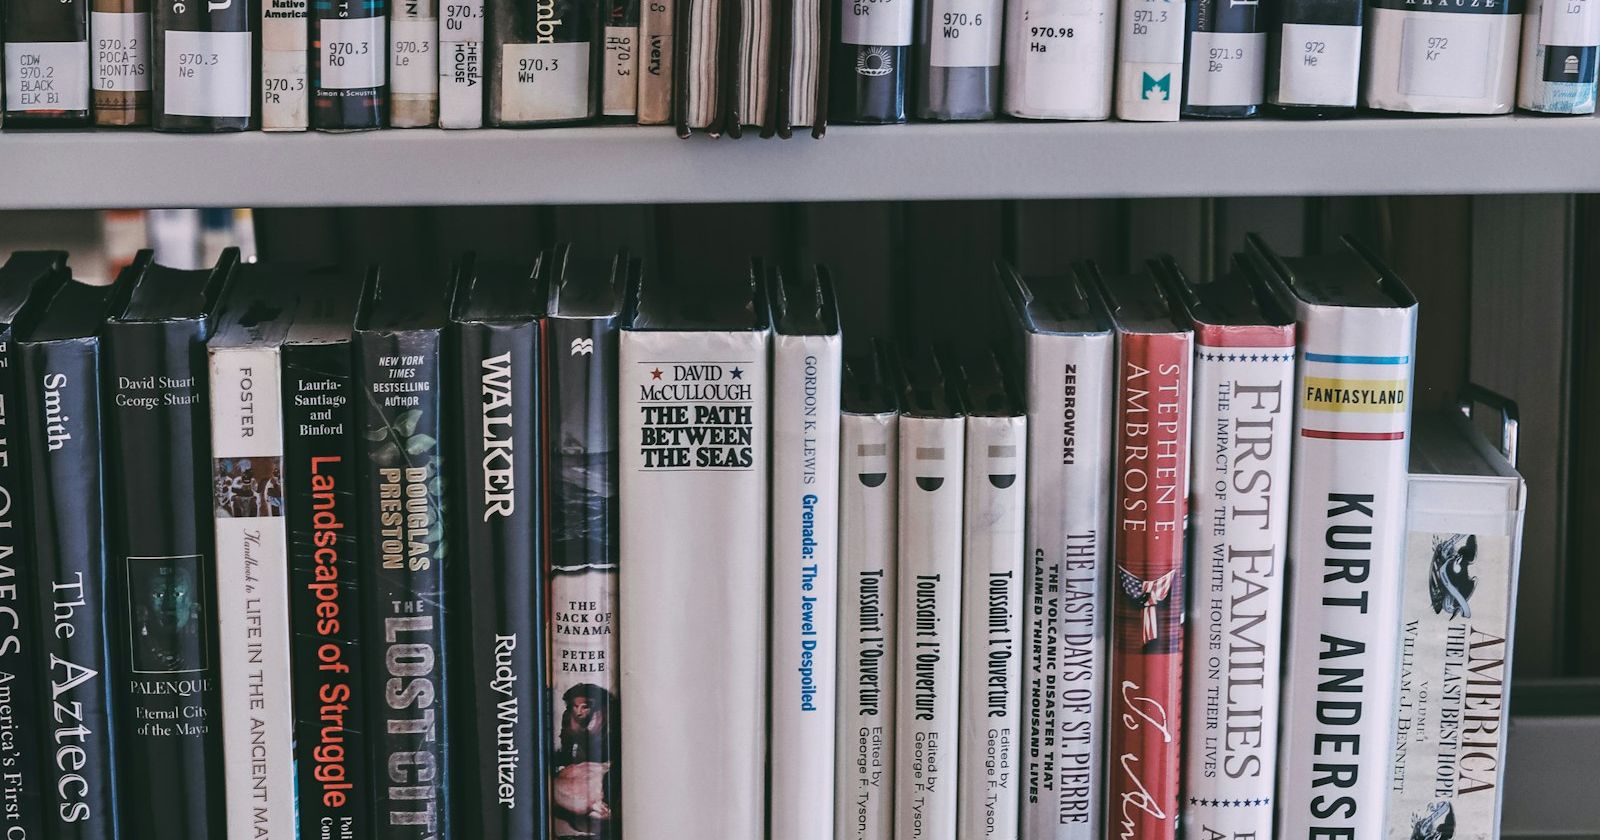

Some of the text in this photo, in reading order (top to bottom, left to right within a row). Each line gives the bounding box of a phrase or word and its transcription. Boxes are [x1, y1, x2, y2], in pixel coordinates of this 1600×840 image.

[272, 0, 305, 8] Native
[446, 5, 484, 18] 970.3
[944, 13, 982, 26] 970.6
[1133, 10, 1168, 22] 971.3
[1031, 26, 1074, 38] 970.98
[99, 38, 137, 50] 970.2
[329, 42, 368, 55] 970.3
[396, 42, 429, 53] 970.3
[1030, 42, 1046, 52] Ha
[1304, 42, 1325, 54] 972
[1428, 37, 1448, 50] 972
[20, 55, 41, 66] CDW
[179, 54, 219, 66] 970.3
[396, 54, 409, 66] Le
[618, 37, 630, 76] 970.3
[1209, 48, 1243, 60] 971.9
[1304, 55, 1317, 66] He
[1426, 50, 1440, 61] Kr
[99, 64, 145, 76] HONTAS
[179, 66, 194, 78] Ne
[455, 44, 465, 83] HOUSE
[518, 58, 558, 71] 970.3
[1208, 60, 1222, 72] Be
[20, 67, 54, 78] 970.2
[20, 80, 54, 92] BLACK
[264, 78, 304, 91] 970.3
[20, 92, 42, 104] ELK
[379, 356, 425, 366] NEW YORK
[388, 368, 415, 378] TIMES
[673, 366, 722, 381] DAVID
[118, 376, 195, 390] David Stuart
[298, 379, 342, 391] Lauria-
[373, 382, 430, 392] BESTSELLING
[294, 394, 347, 406] Santiago
[640, 384, 752, 400] McCULLOUGH
[1307, 386, 1404, 404] FANTASYLAND
[115, 392, 200, 410] George Stuart
[239, 366, 254, 438] FOSTER
[384, 396, 420, 406] AUTHOR
[44, 373, 72, 452] Smith
[310, 410, 332, 420] and
[640, 406, 752, 424] THE PATH
[1063, 364, 1076, 464] ZEBROWSKI
[300, 424, 343, 436] Binford
[482, 351, 514, 522] WALKER
[640, 426, 752, 446] BETWEEN
[1122, 362, 1150, 532] AMBROSE
[1154, 363, 1180, 540] STEPHEN E.
[1232, 380, 1282, 530] FIRST
[640, 448, 753, 468] THE SEAS
[380, 468, 404, 570] PRESTON
[406, 467, 430, 572] DOUGLAS
[798, 356, 818, 712] GORDON K. LEWIS Grenada: The Jewel Despoiled
[1322, 492, 1374, 614] KURT
[1204, 381, 1230, 778] THE IMPACT OF THE WHITE HOUSE ON THEIR LIVES
[391, 600, 424, 614] THE
[569, 602, 596, 610] THE
[556, 612, 612, 623] SACK OF
[308, 456, 353, 808] Landscapes of Struggle
[859, 569, 884, 716] Toussaint L'Ouverture
[915, 574, 940, 721] Toussaint L'Ouverture
[988, 570, 1012, 718] Toussaint L'Ouverture
[562, 650, 606, 660] PETER
[1224, 544, 1276, 778] FAMILIES
[244, 528, 268, 802] Handbook to LIFE IN THE ANCIENT
[562, 662, 606, 672] EARLE
[385, 616, 436, 742] LOST
[1029, 548, 1044, 804] CLAIMED THIRTY THOUSAND LIVES
[1043, 564, 1058, 791] THE VOLCANIC DISASTER THAT
[1060, 530, 1096, 824] THE LAST DAYS OF ST. PIERRE
[130, 678, 212, 696] PALENQUE
[50, 571, 98, 822] The Aztecs
[136, 705, 208, 720] Eternal City
[1393, 620, 1419, 794] WILLIAM J. BENNETT
[1417, 680, 1428, 736] VOLUME
[1434, 624, 1466, 798] THE LAST BEST HOPE
[1458, 625, 1506, 796] AMERICA
[490, 633, 520, 810] Rudy Wurlitzer
[137, 723, 208, 738] of the Maya
[0, 671, 22, 820] America's First
[870, 726, 882, 787] Edited by
[926, 732, 938, 792] Edited by
[998, 728, 1010, 788] Edited by
[857, 726, 870, 835] George F. Tyson,
[912, 732, 926, 839] George F. Tyson,
[986, 728, 998, 837] George F. Tyson,
